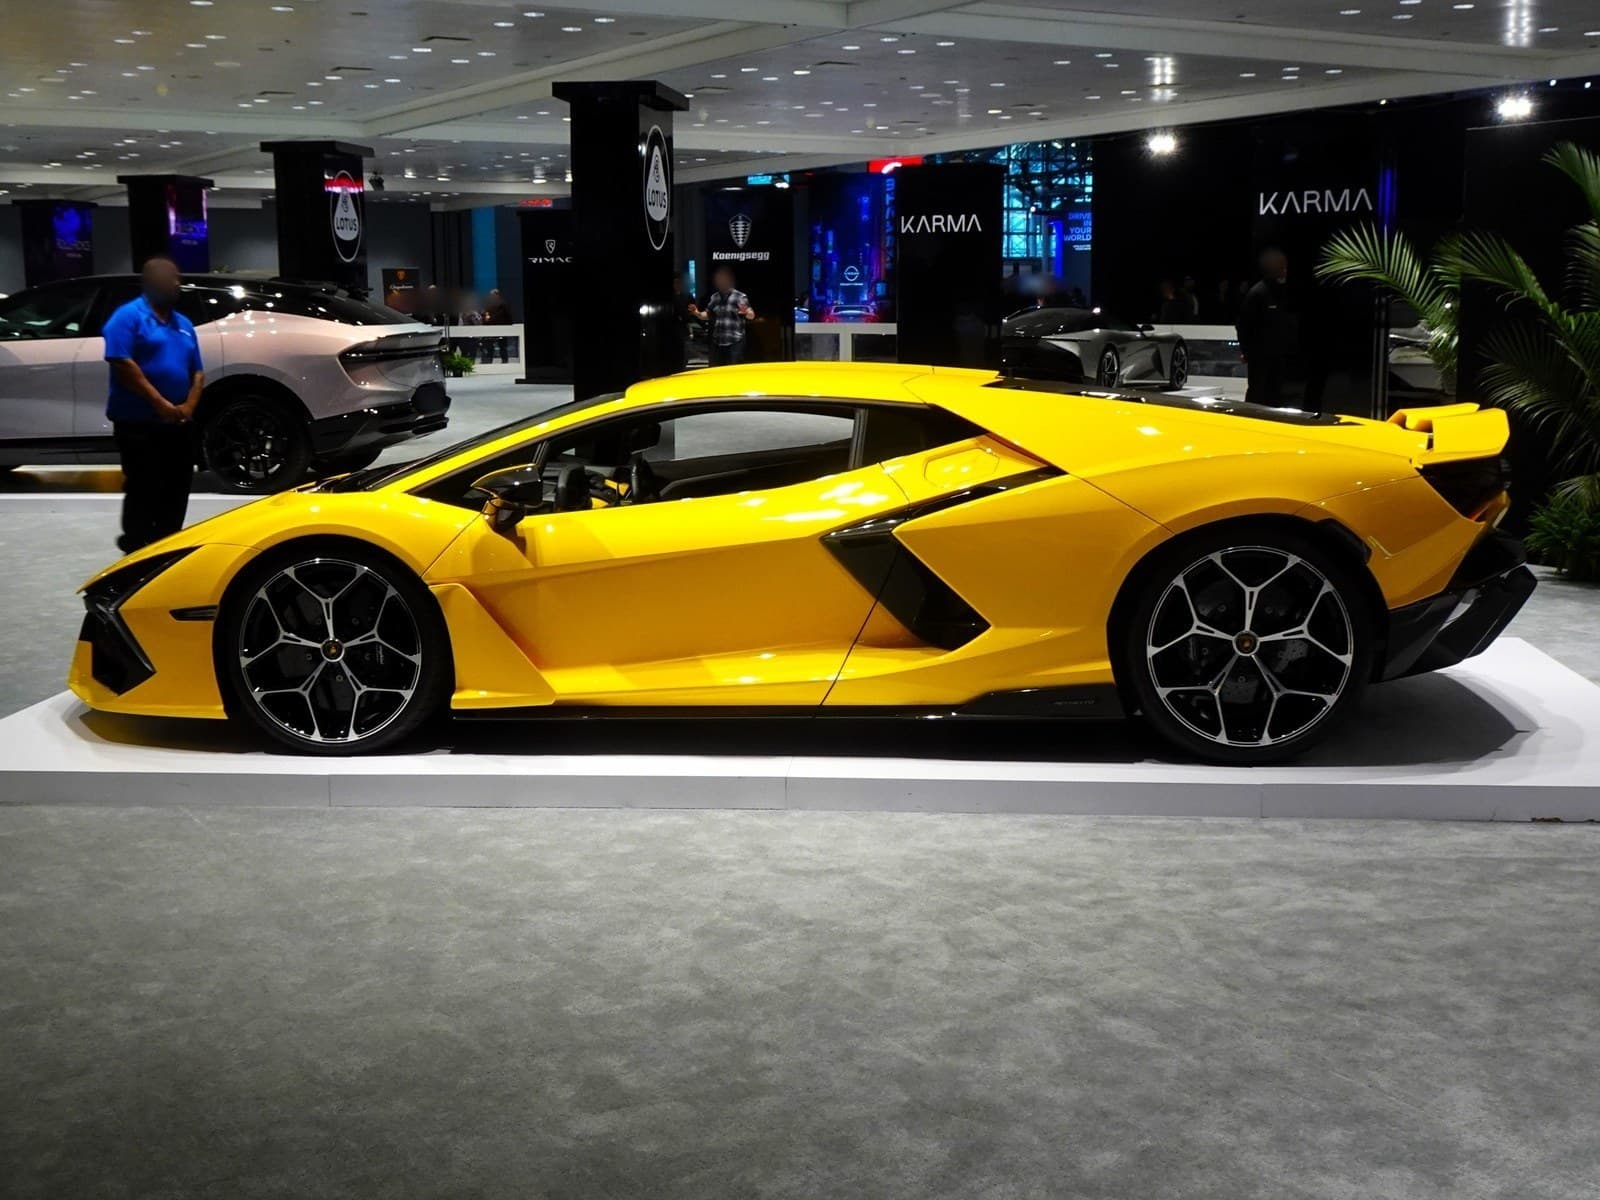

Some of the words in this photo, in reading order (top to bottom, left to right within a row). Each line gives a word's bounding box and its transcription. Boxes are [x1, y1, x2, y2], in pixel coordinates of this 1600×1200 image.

[648, 189, 667, 209] LOTUS
[1259, 188, 1374, 215] KARMA
[335, 217, 358, 232] LOTUS
[900, 214, 982, 234] KARMA
[1069, 226, 1093, 234] YOUR
[1063, 234, 1093, 242] WORLD
[527, 256, 574, 264] RIMAC
[712, 251, 770, 262] Koenigsegg
